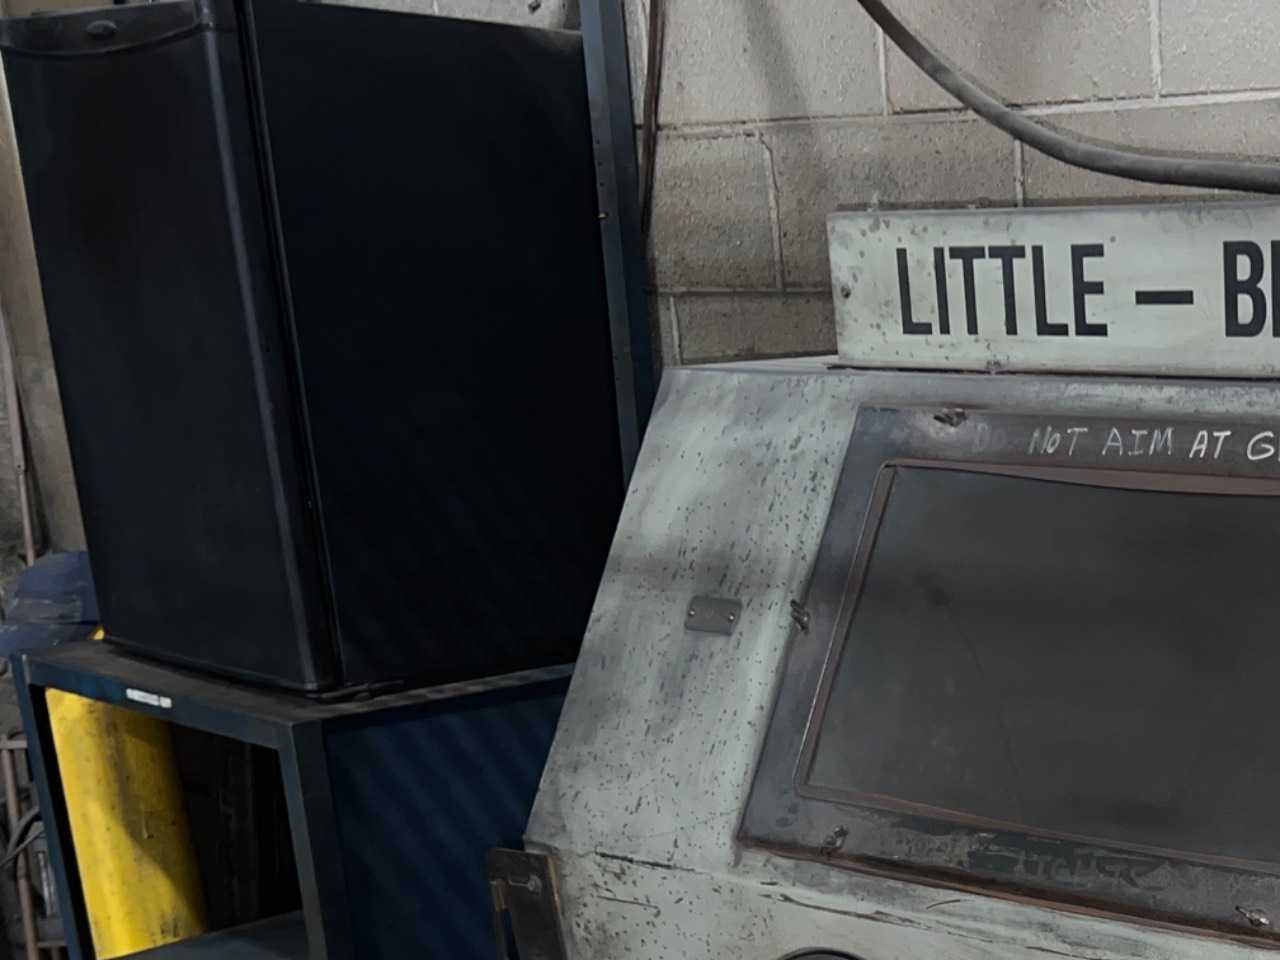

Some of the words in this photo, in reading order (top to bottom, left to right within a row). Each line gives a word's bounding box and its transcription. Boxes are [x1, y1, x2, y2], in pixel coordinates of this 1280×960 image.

[896, 243, 1108, 337] LITTLE
[1101, 426, 1175, 456] AIM
[1188, 430, 1232, 459] AT
